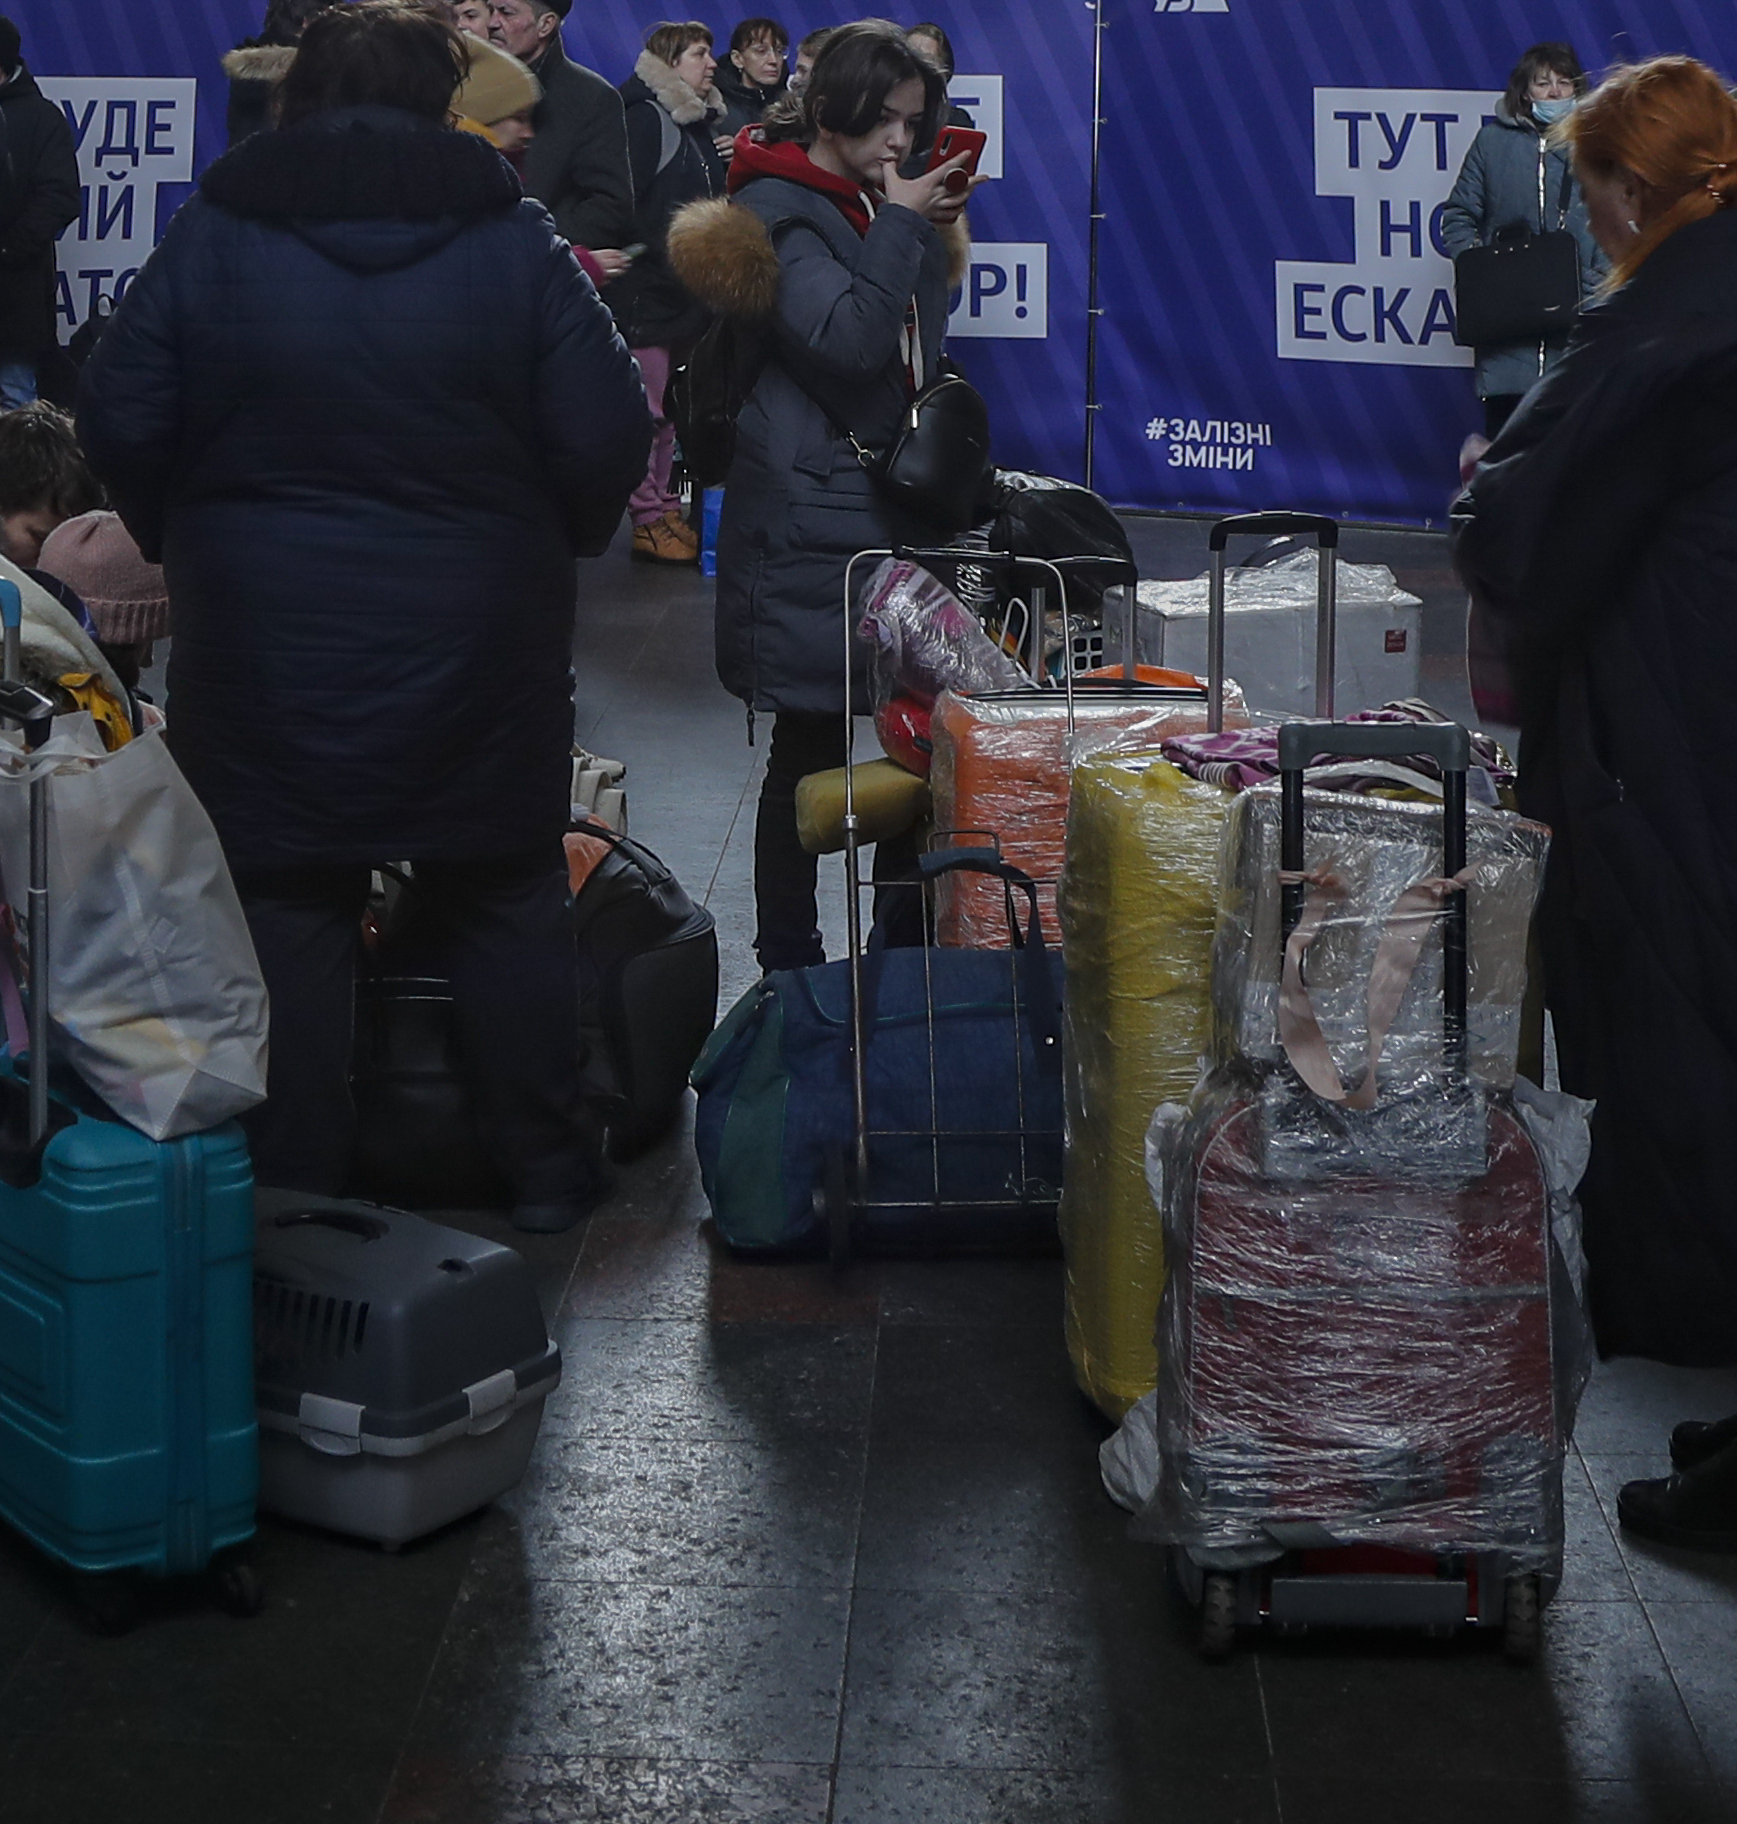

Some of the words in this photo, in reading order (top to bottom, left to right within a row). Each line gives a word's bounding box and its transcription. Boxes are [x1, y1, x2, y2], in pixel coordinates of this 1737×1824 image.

[61, 99, 177, 168] УДЕ
[1334, 111, 1459, 171] ТУТ
[1145, 417, 1272, 447] #ЗАЛІЗНІ
[1167, 443, 1254, 472] ЗМІНИ
